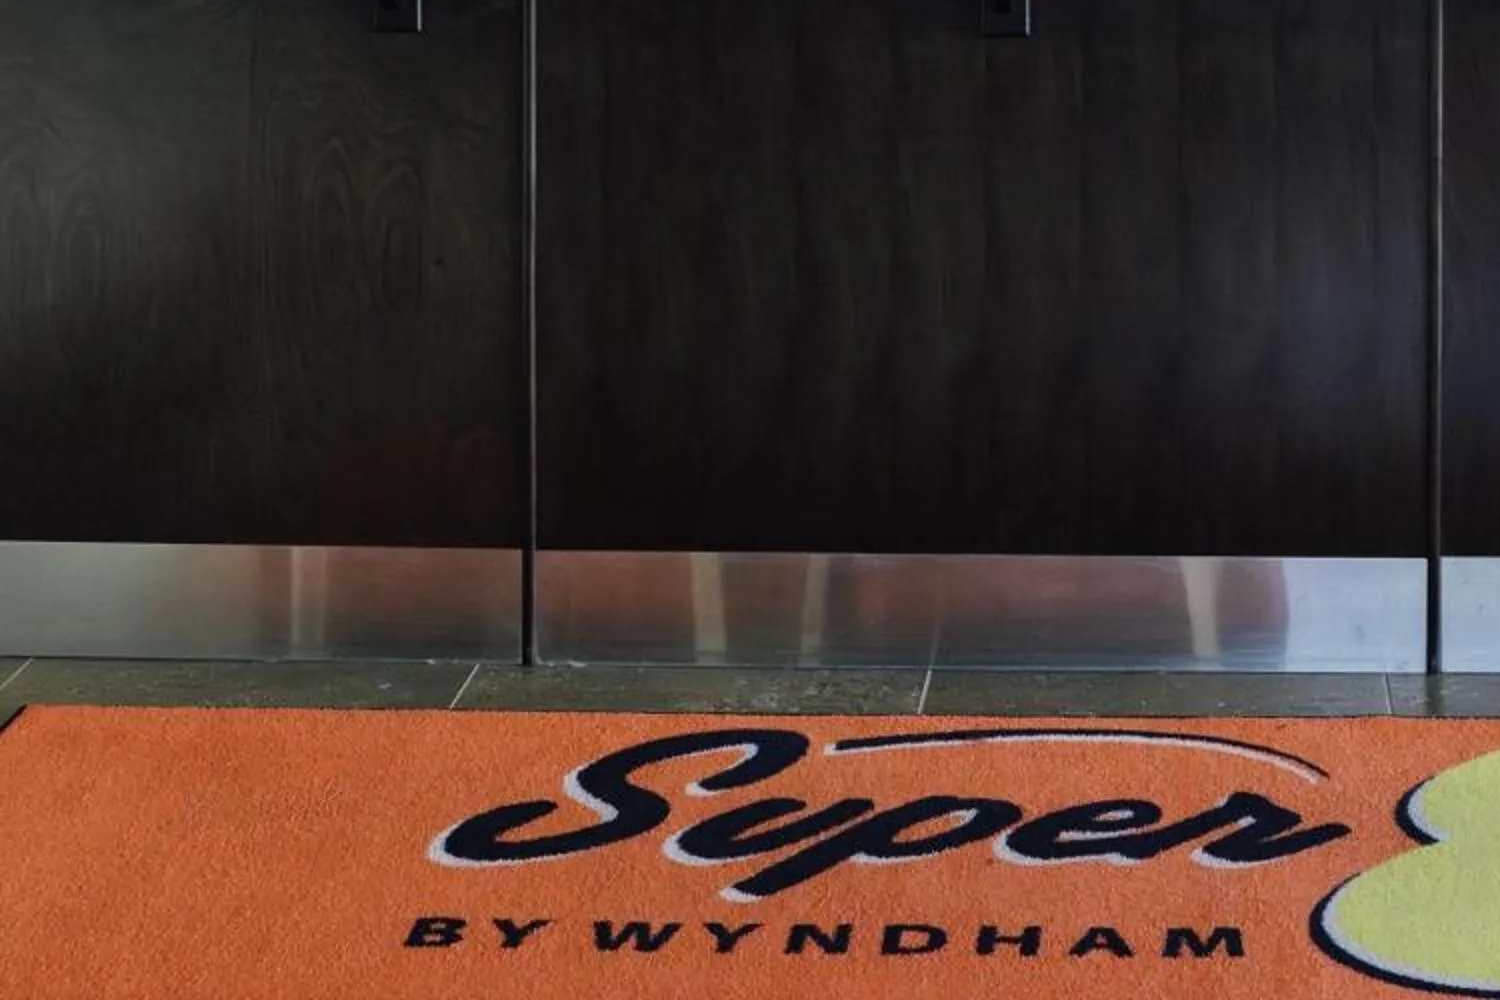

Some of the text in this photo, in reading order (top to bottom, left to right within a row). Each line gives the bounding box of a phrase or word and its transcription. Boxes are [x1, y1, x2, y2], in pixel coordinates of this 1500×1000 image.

[425, 729, 1352, 902] Super
[402, 916, 1249, 960] BY WYNDHAM
